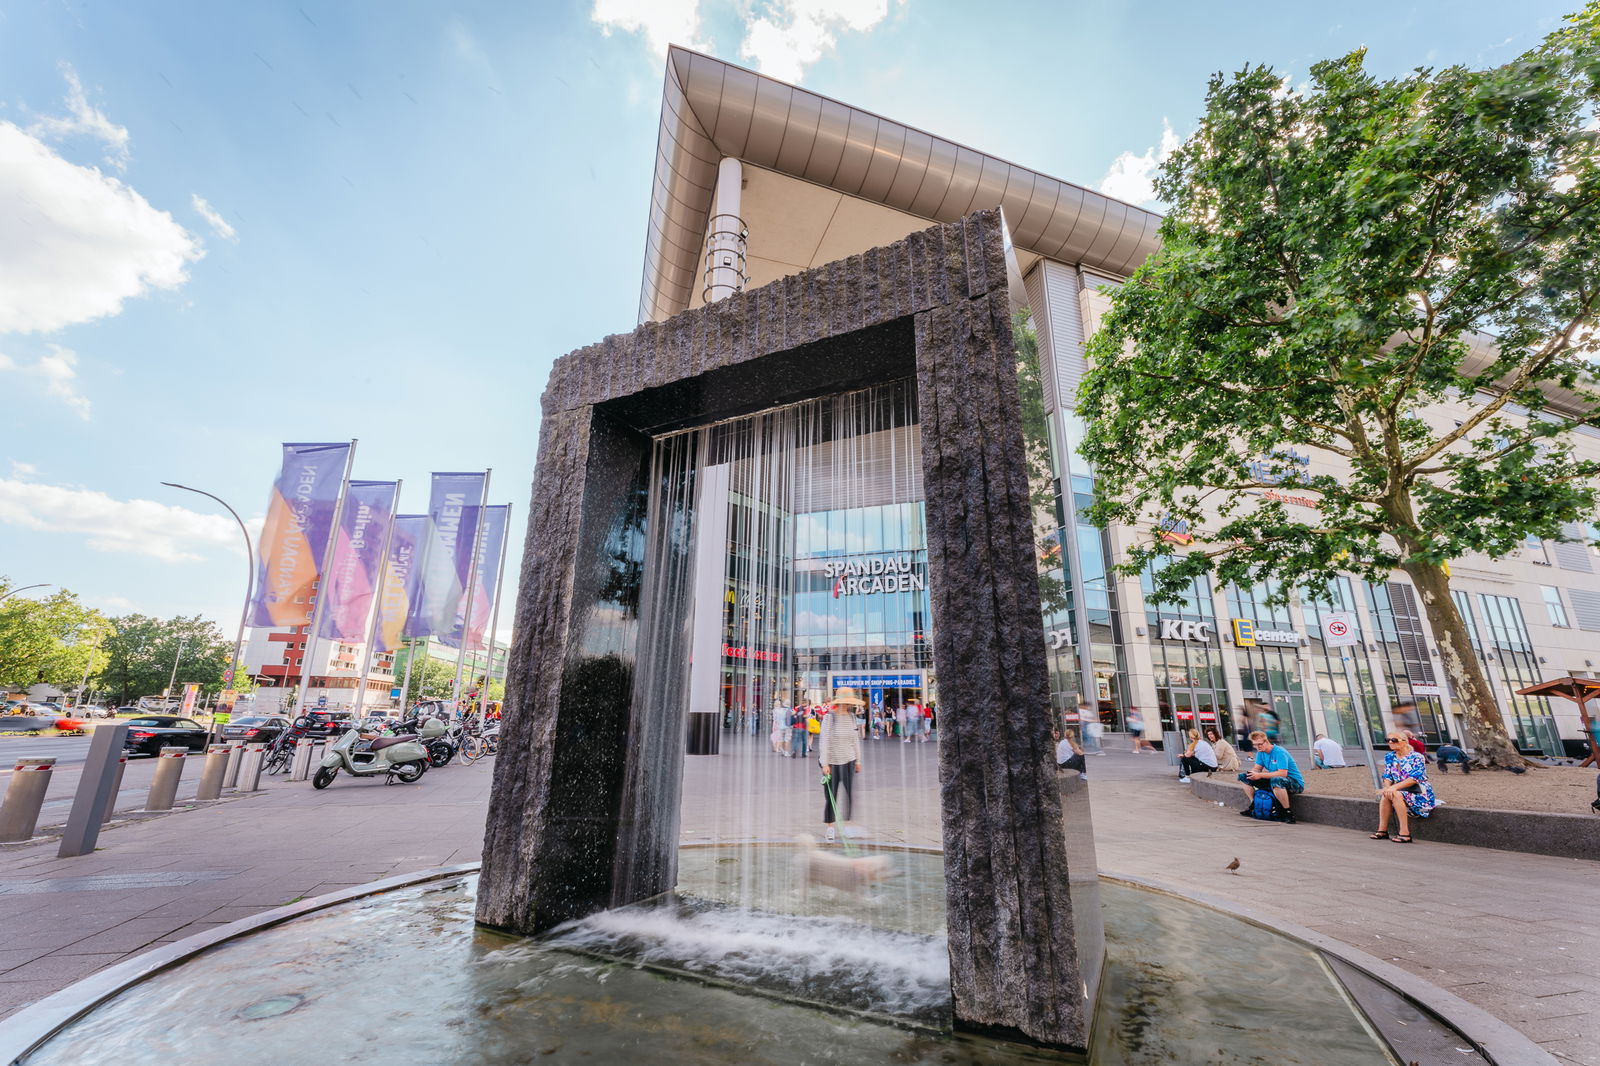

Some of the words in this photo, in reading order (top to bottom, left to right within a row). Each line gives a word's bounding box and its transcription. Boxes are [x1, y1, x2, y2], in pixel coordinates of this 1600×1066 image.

[1291, 496, 1323, 510] FITNE
[824, 556, 912, 578] SPANDAU
[837, 573, 924, 596] ARCADEN
[1160, 618, 1211, 642] KFC
[1255, 629, 1300, 643] center
[721, 642, 747, 659] Foot
